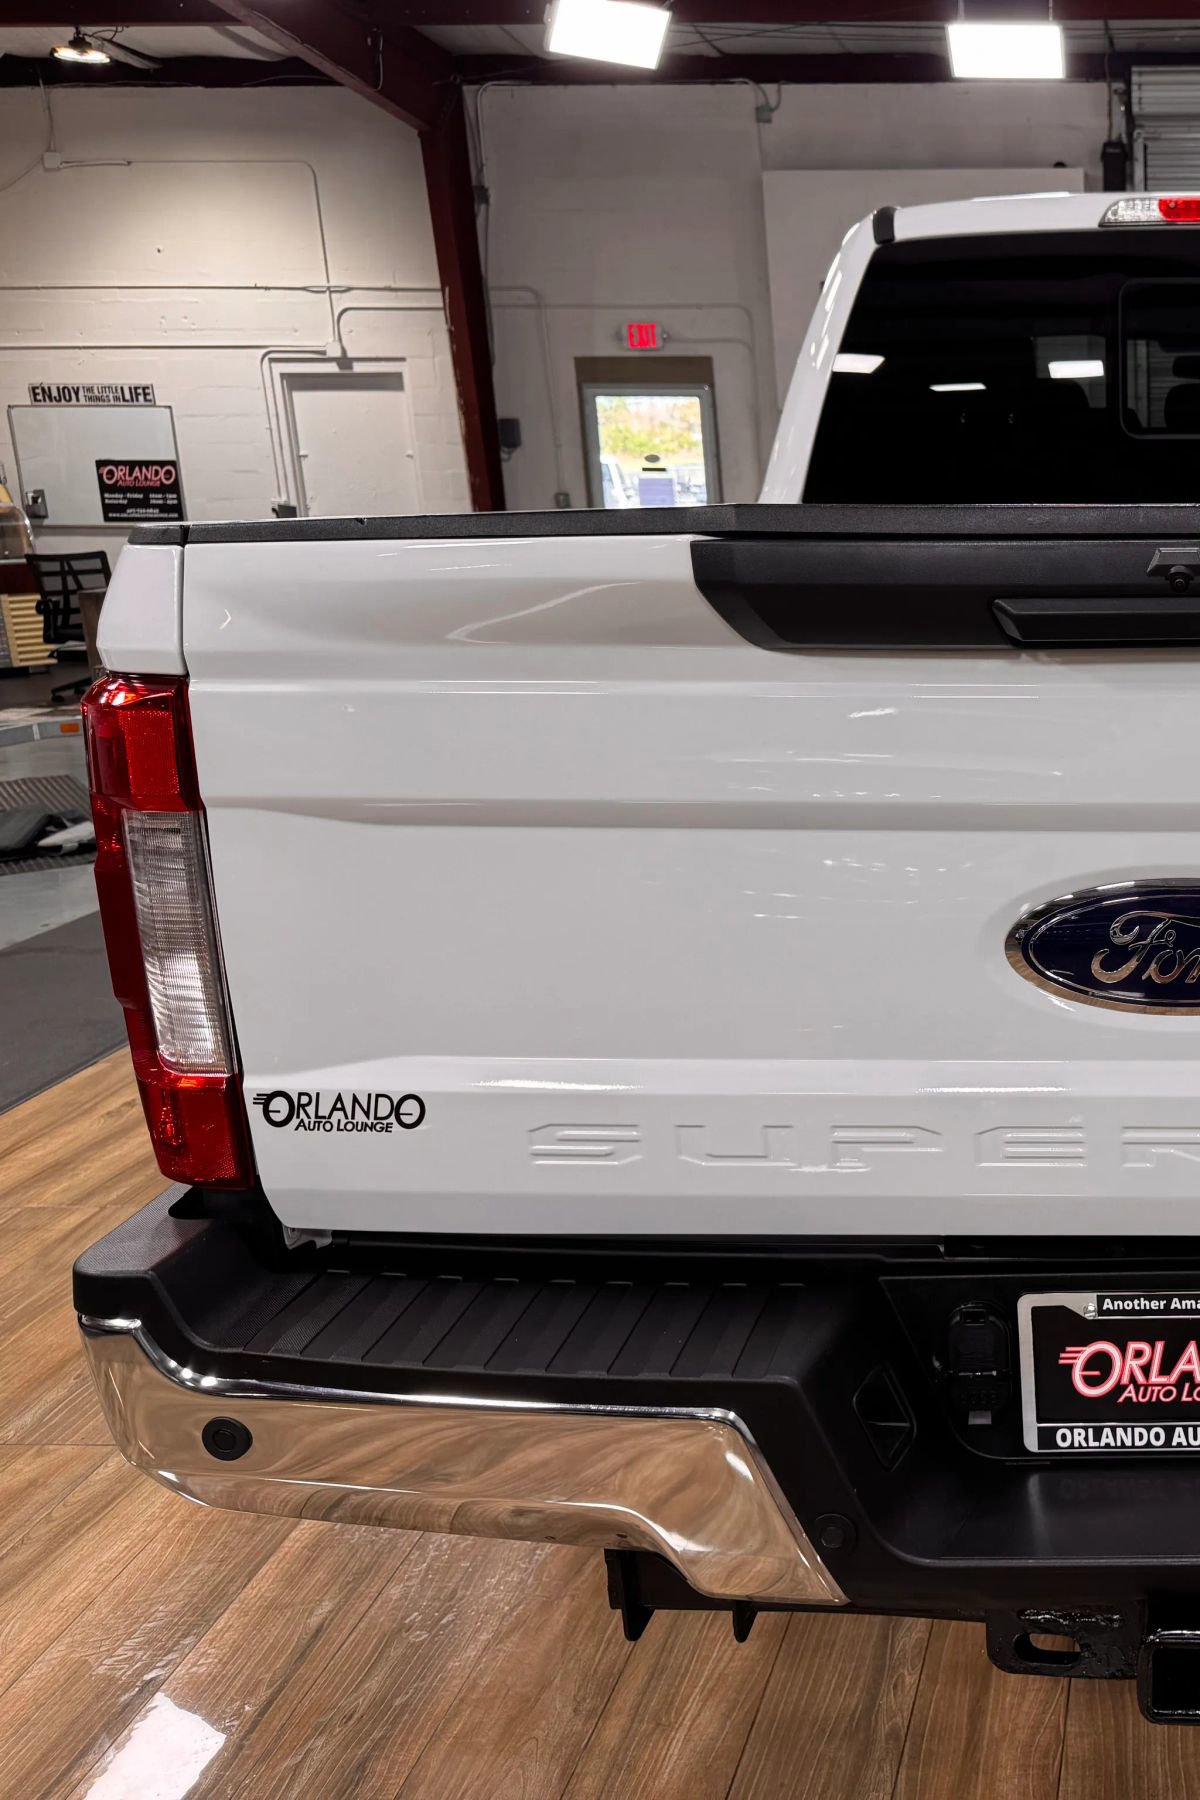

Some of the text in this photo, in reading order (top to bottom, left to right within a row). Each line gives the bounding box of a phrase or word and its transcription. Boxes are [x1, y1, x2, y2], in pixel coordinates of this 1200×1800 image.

[627, 323, 657, 348] EXIT
[31, 386, 80, 403] ENJOY
[82, 385, 120, 394] THE LITTLE
[121, 386, 153, 403] LIFE
[83, 394, 121, 403] THINGS IN
[101, 465, 176, 485] ORLANDO
[117, 479, 161, 487] AUTO LOUNGE
[254, 1090, 426, 1130] ORLANDO
[294, 1118, 394, 1133] AUTO LOUNGE
[1102, 1297, 1167, 1311] Another
[1117, 1382, 1178, 1403] AUTO
[1055, 1427, 1165, 1448] ORLANDO
